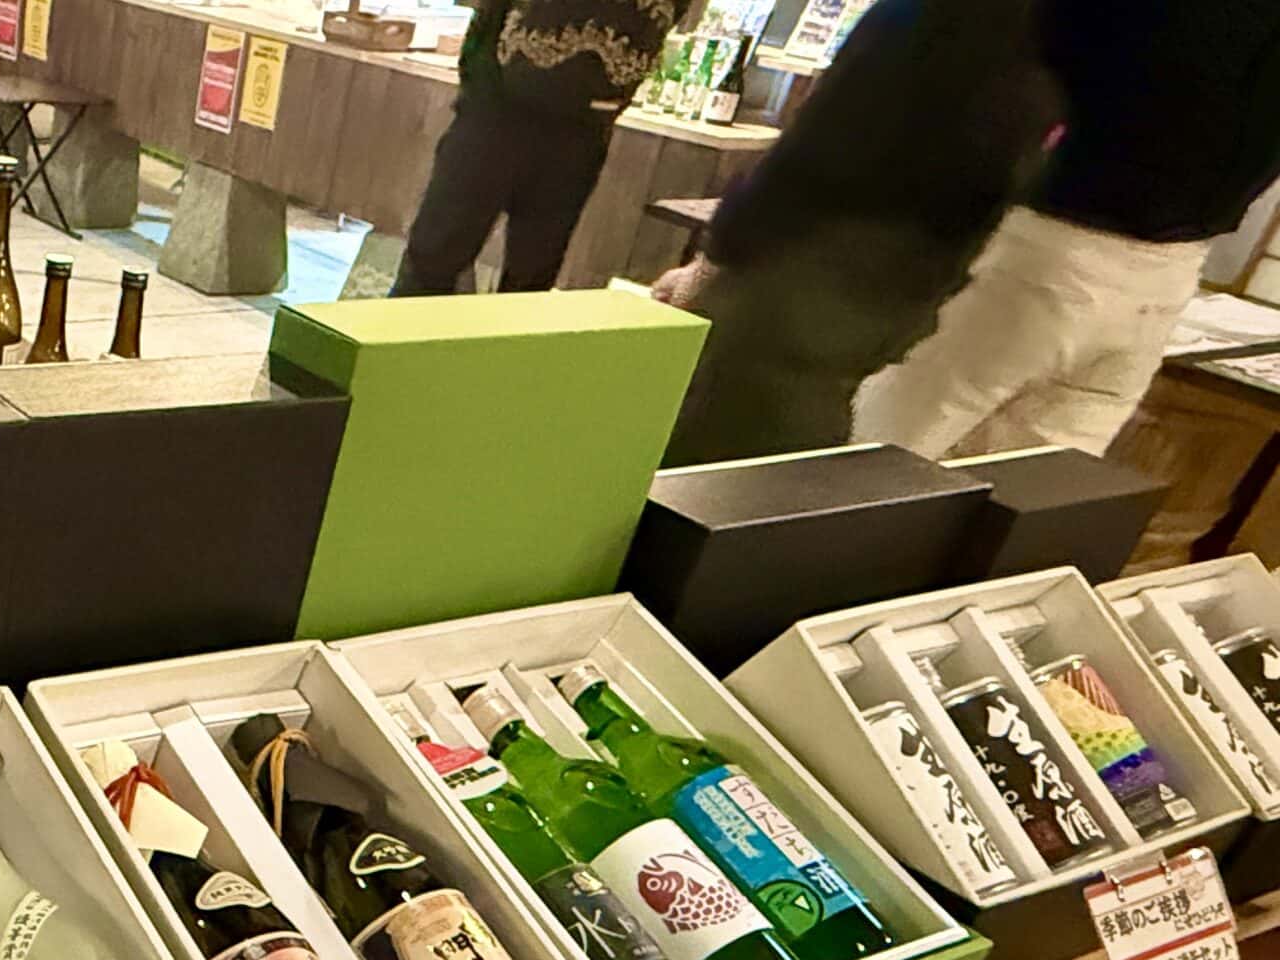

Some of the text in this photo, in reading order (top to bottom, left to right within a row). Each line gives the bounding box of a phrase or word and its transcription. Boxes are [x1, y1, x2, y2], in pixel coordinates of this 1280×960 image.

[1100, 888, 1191, 942] 季節のご挨拶
